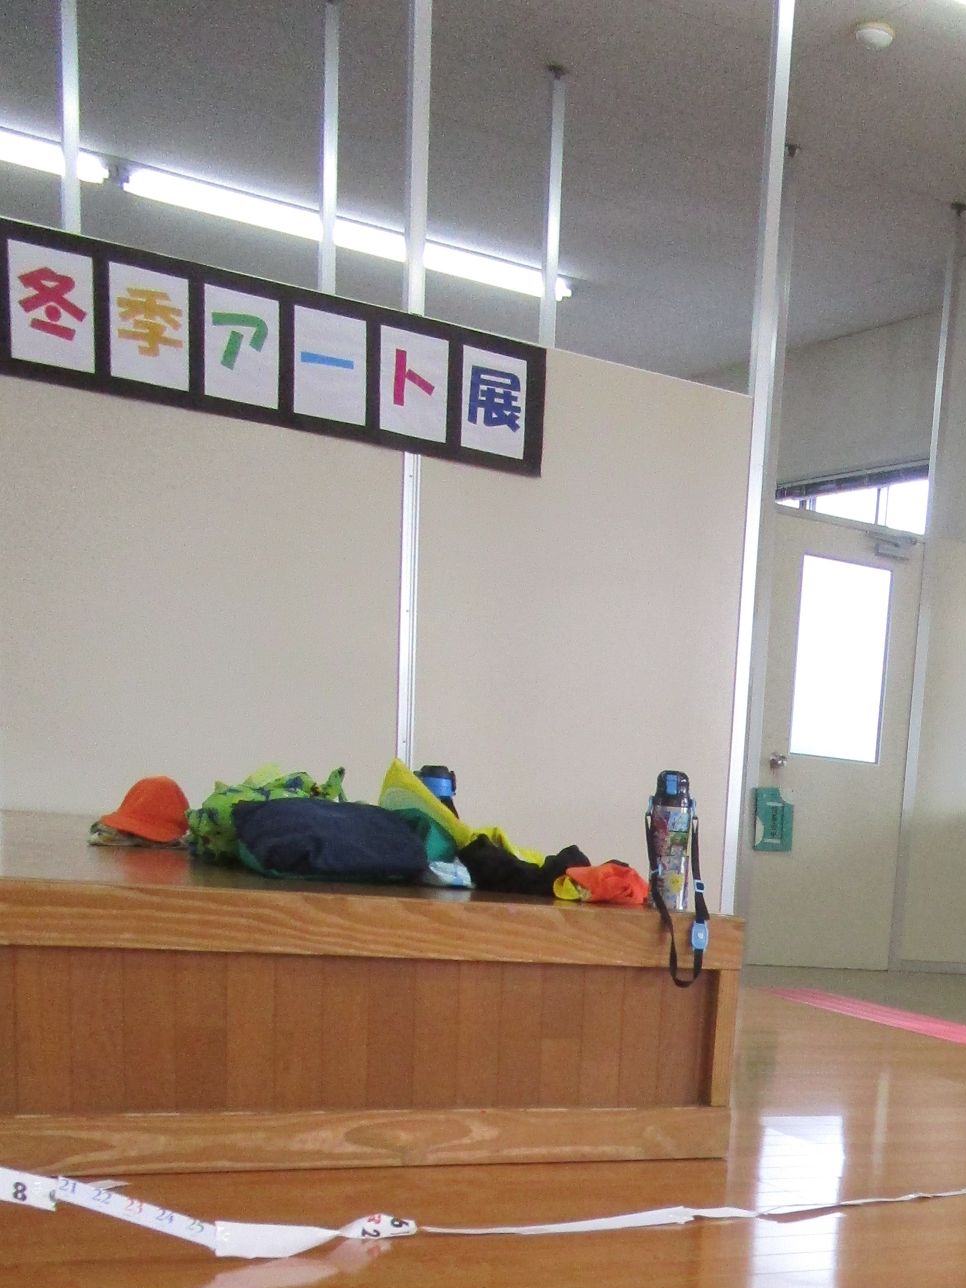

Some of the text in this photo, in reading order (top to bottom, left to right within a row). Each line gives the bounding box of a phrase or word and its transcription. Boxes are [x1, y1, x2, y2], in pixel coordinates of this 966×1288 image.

[17, 266, 522, 433] 冬季アート展
